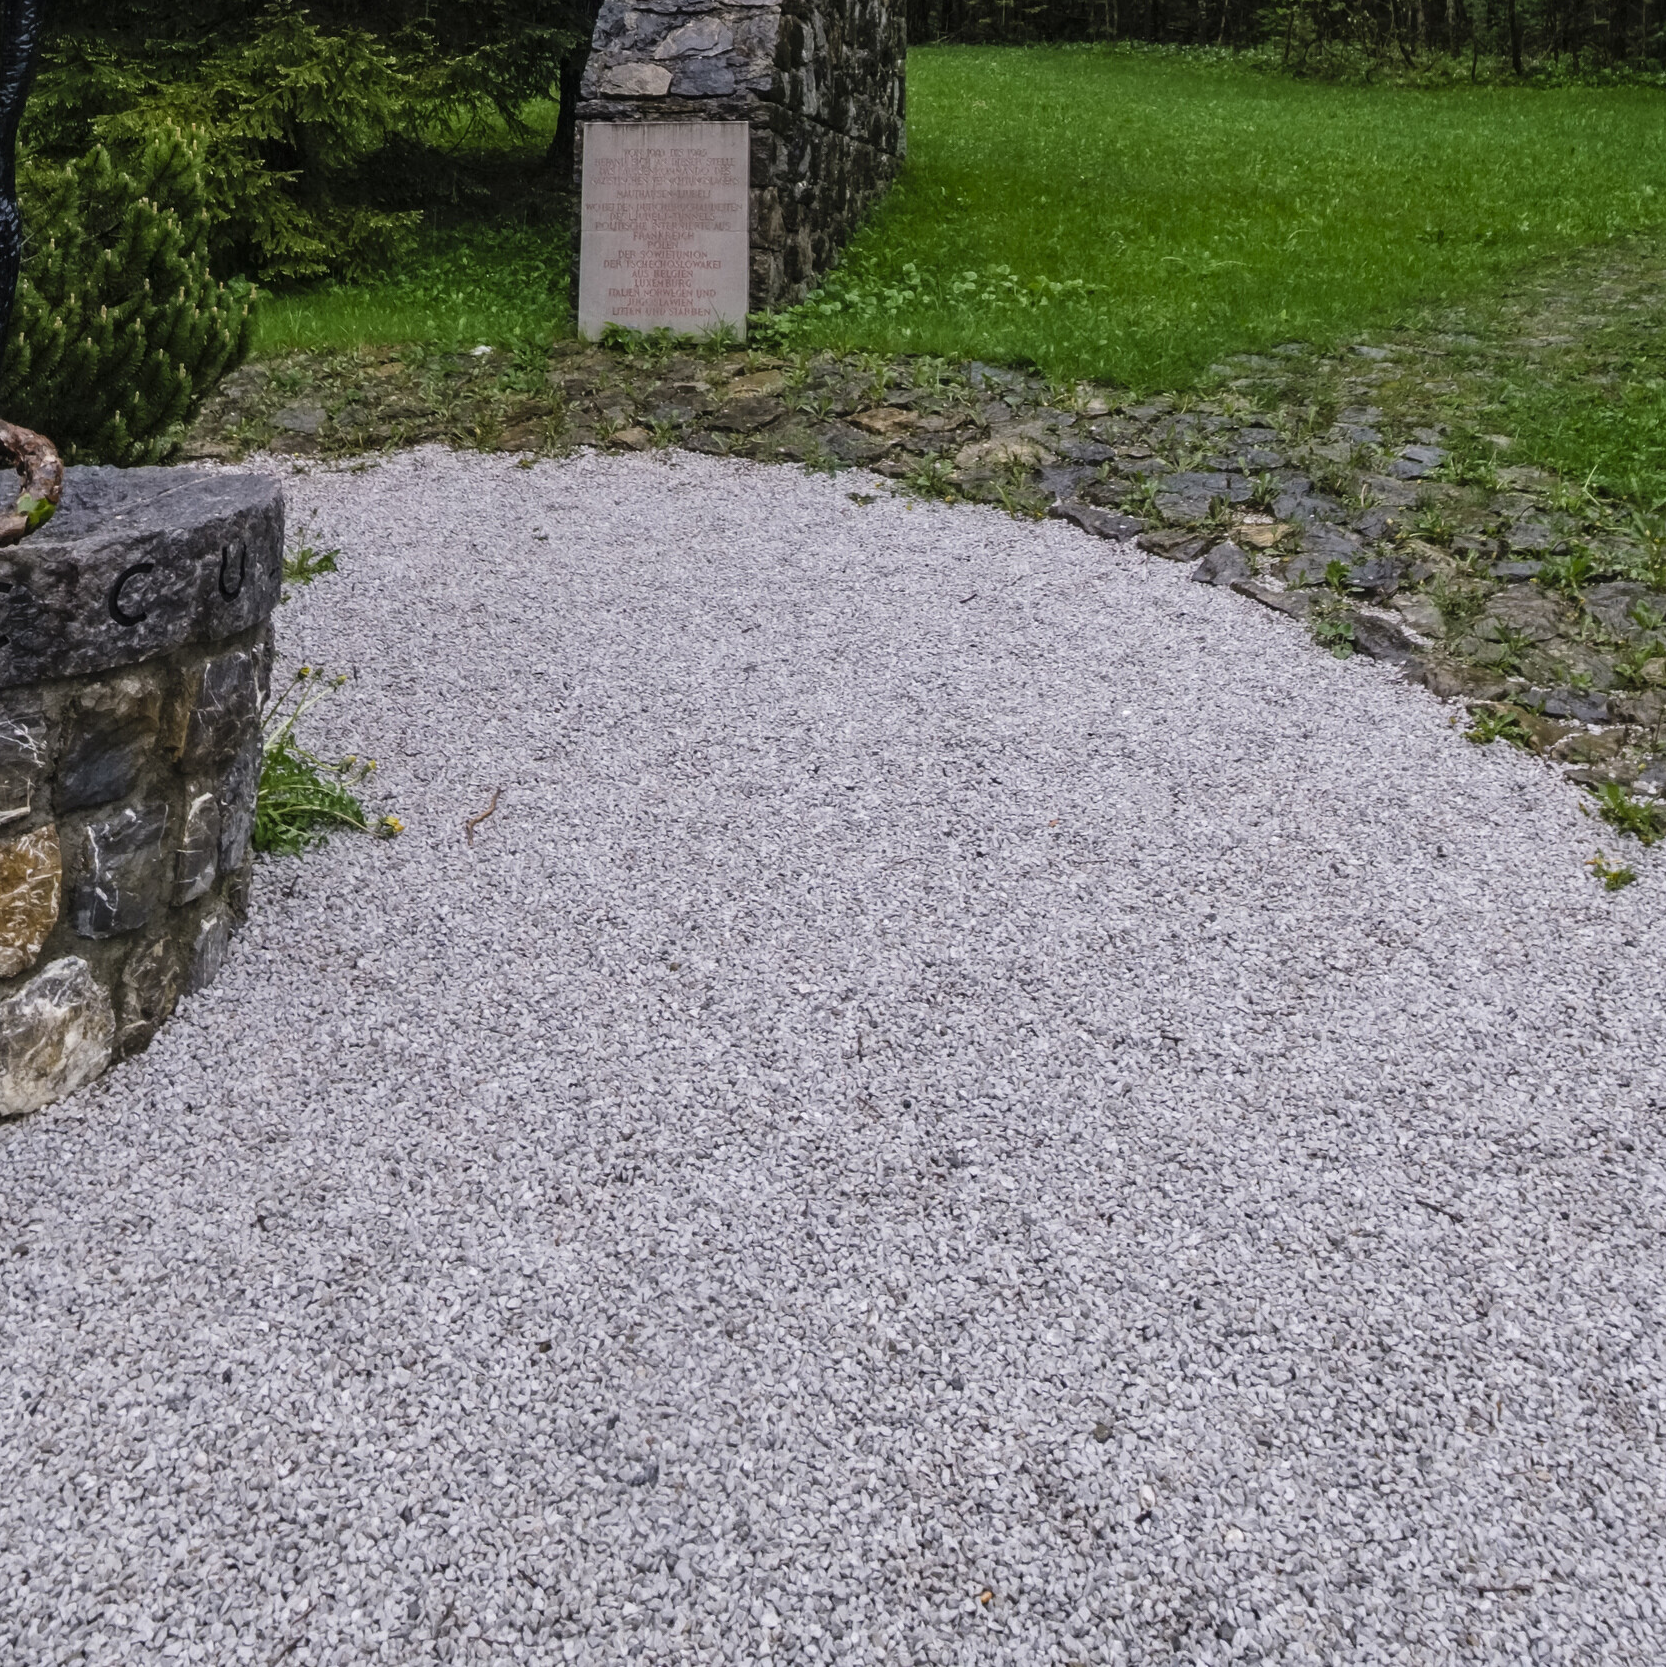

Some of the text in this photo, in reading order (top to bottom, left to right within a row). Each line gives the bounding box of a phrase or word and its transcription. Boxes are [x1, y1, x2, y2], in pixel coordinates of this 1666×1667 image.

[633, 231, 694, 240] FRANKREICH
[647, 241, 678, 249] POLEN
[618, 250, 636, 259] DER
[604, 260, 722, 269] DER TSCHECHOSLOWAKEI
[632, 270, 693, 278] AUS BELGIEN
[635, 279, 691, 287] LUXEMBURG
[696, 289, 716, 297] UND
[646, 308, 665, 316] UND
[669, 308, 711, 316] STARBEN
